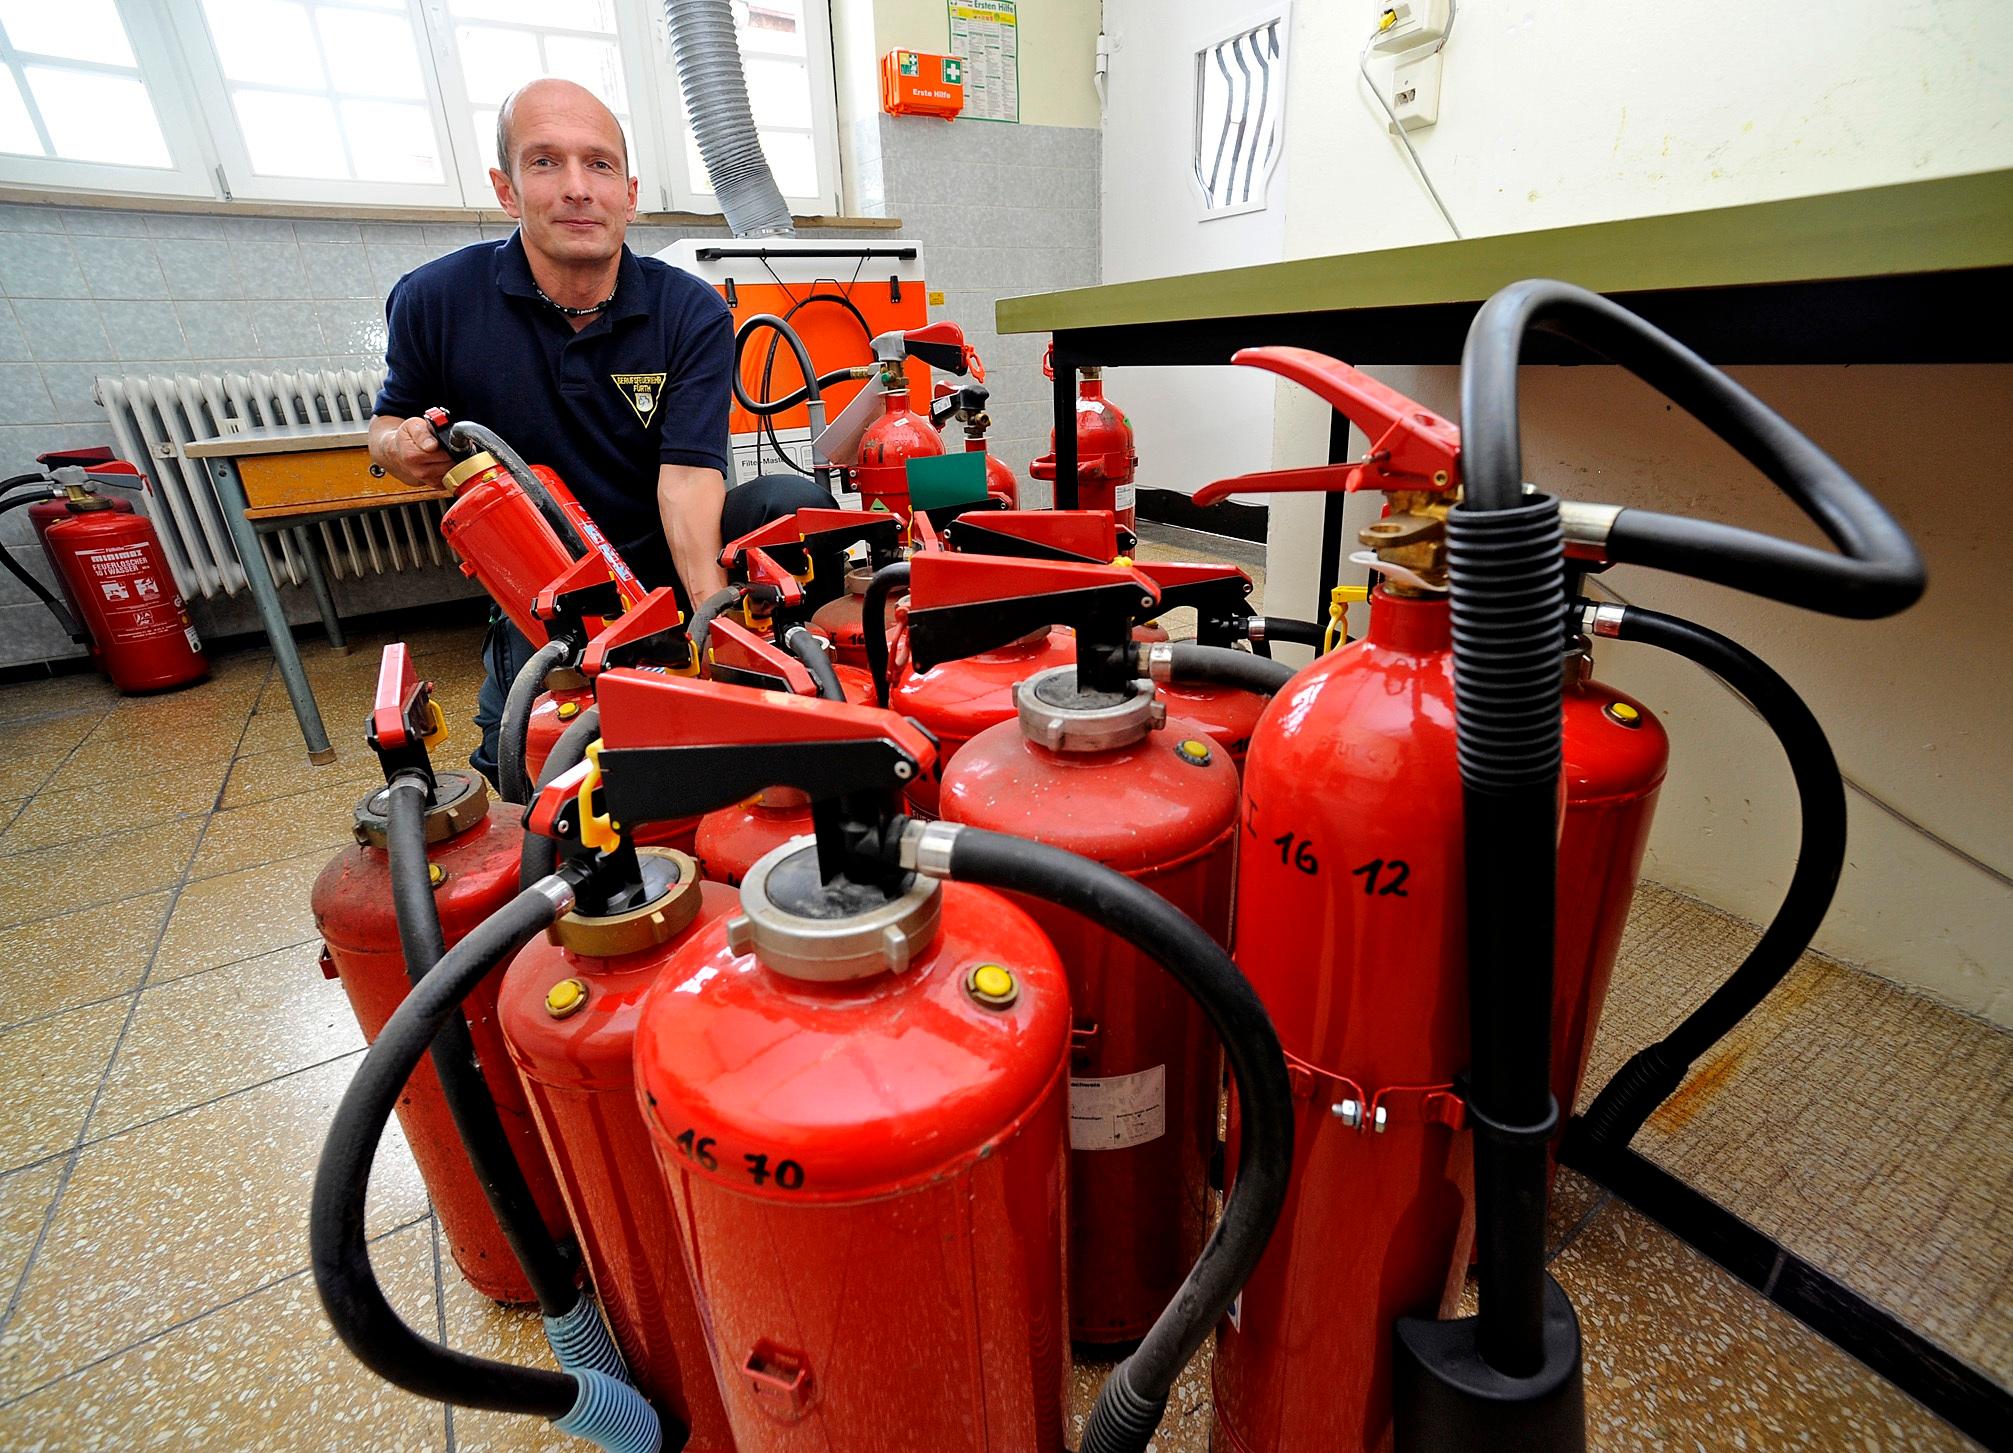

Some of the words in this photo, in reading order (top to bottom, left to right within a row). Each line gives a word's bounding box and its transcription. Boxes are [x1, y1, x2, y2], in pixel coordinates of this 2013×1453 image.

[974, 0, 997, 10] Ersten
[912, 88, 933, 97] Erste
[934, 90, 951, 99] Hilfe
[1274, 832, 1318, 876] 16
[1352, 859, 1410, 897] 12
[677, 1129, 718, 1172] 16
[744, 1153, 804, 1190] 70
